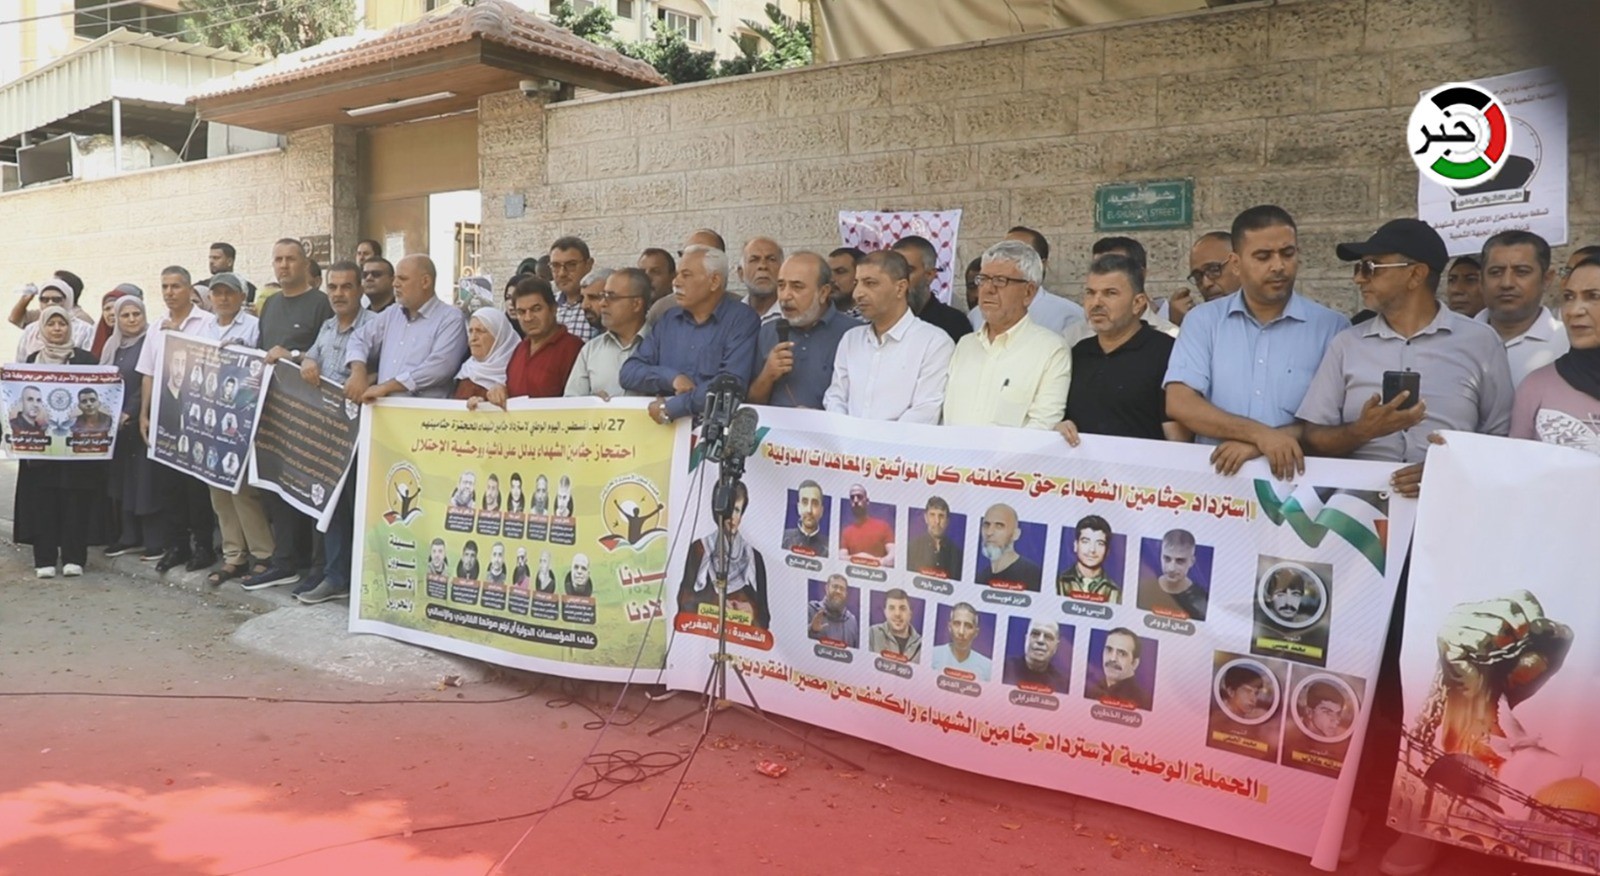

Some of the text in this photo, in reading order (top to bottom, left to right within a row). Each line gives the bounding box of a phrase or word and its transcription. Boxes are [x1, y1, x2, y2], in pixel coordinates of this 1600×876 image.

[607, 418, 626, 432] 27
[767, 443, 1250, 522] إسترداد جثامين الشهداء حق كفلته كل المواثيق والمعاهدات الدولية
[681, 619, 713, 631] المغربي
[738, 656, 1259, 798] الحملة الوطنية لإسترداد جثامين الشهداء والكشف عن مصير المفقودين
